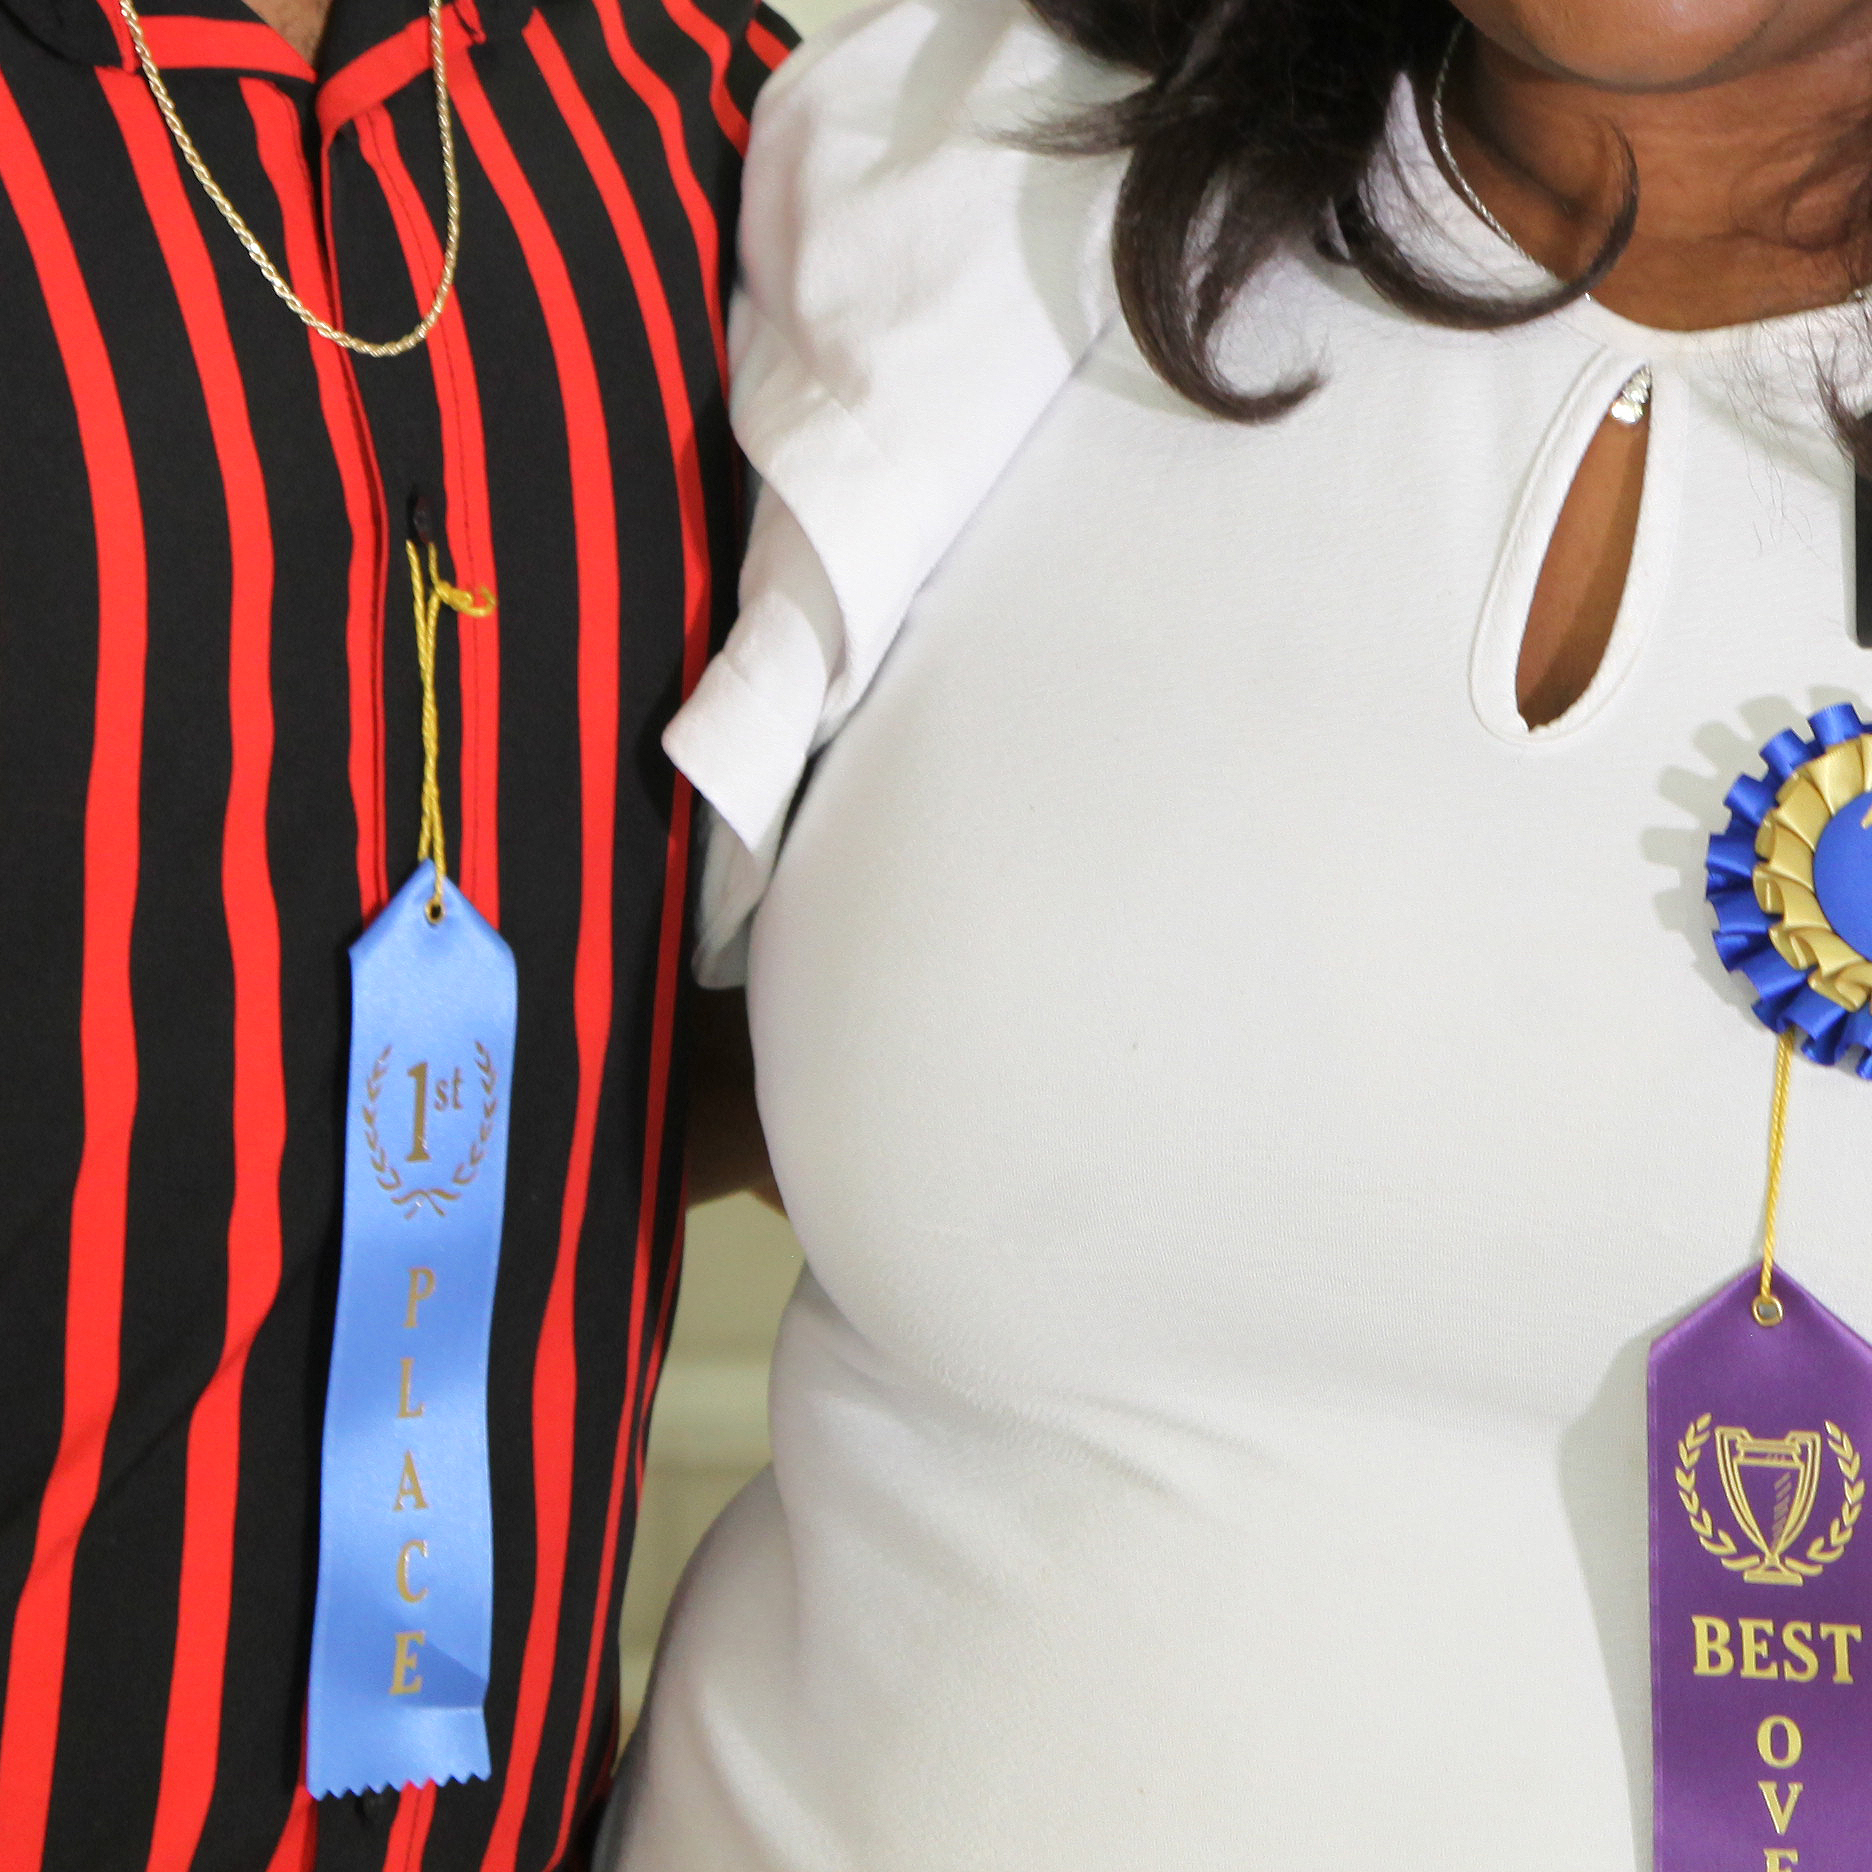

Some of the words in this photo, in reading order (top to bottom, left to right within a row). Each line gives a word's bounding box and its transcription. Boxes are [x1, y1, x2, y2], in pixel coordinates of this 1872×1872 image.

[406, 1061, 463, 1162] 1st
[389, 1266, 436, 1695] PLACE
[1692, 1614, 1862, 1684] BEST
